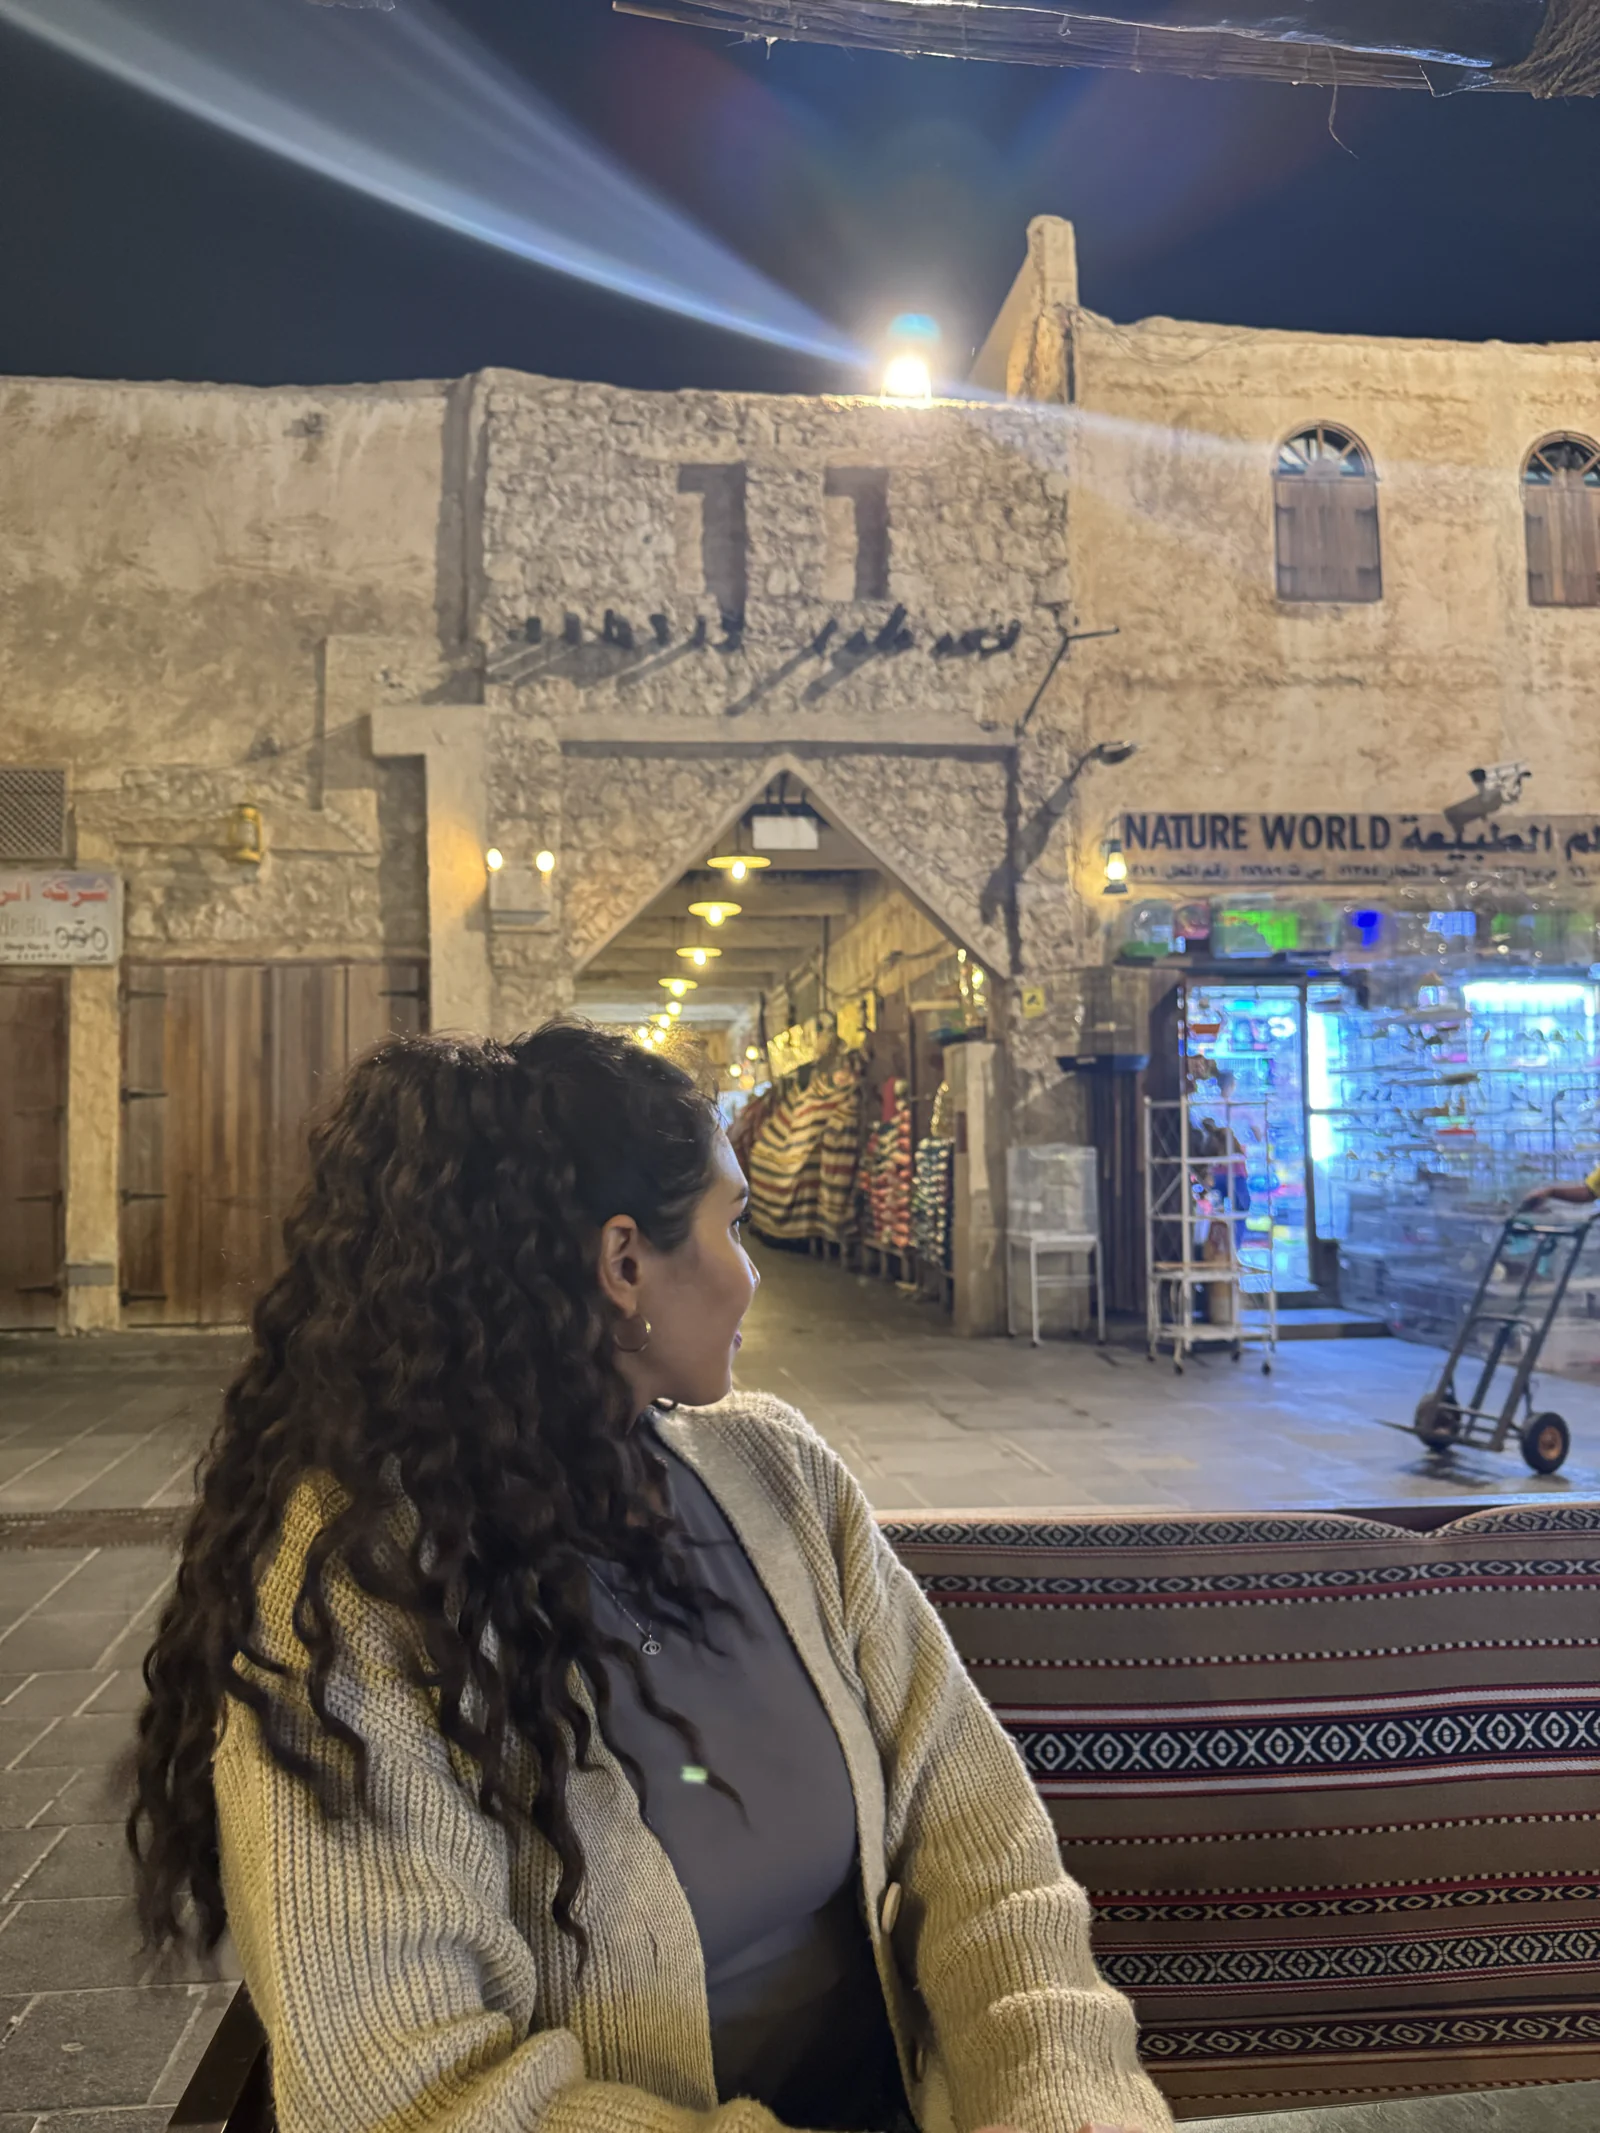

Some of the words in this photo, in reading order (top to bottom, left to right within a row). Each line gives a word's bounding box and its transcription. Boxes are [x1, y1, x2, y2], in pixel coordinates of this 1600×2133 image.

[1125, 815, 1247, 850] NATURE
[1260, 815, 1390, 850] WORLD
[1401, 815, 1551, 860] الطبيعة
